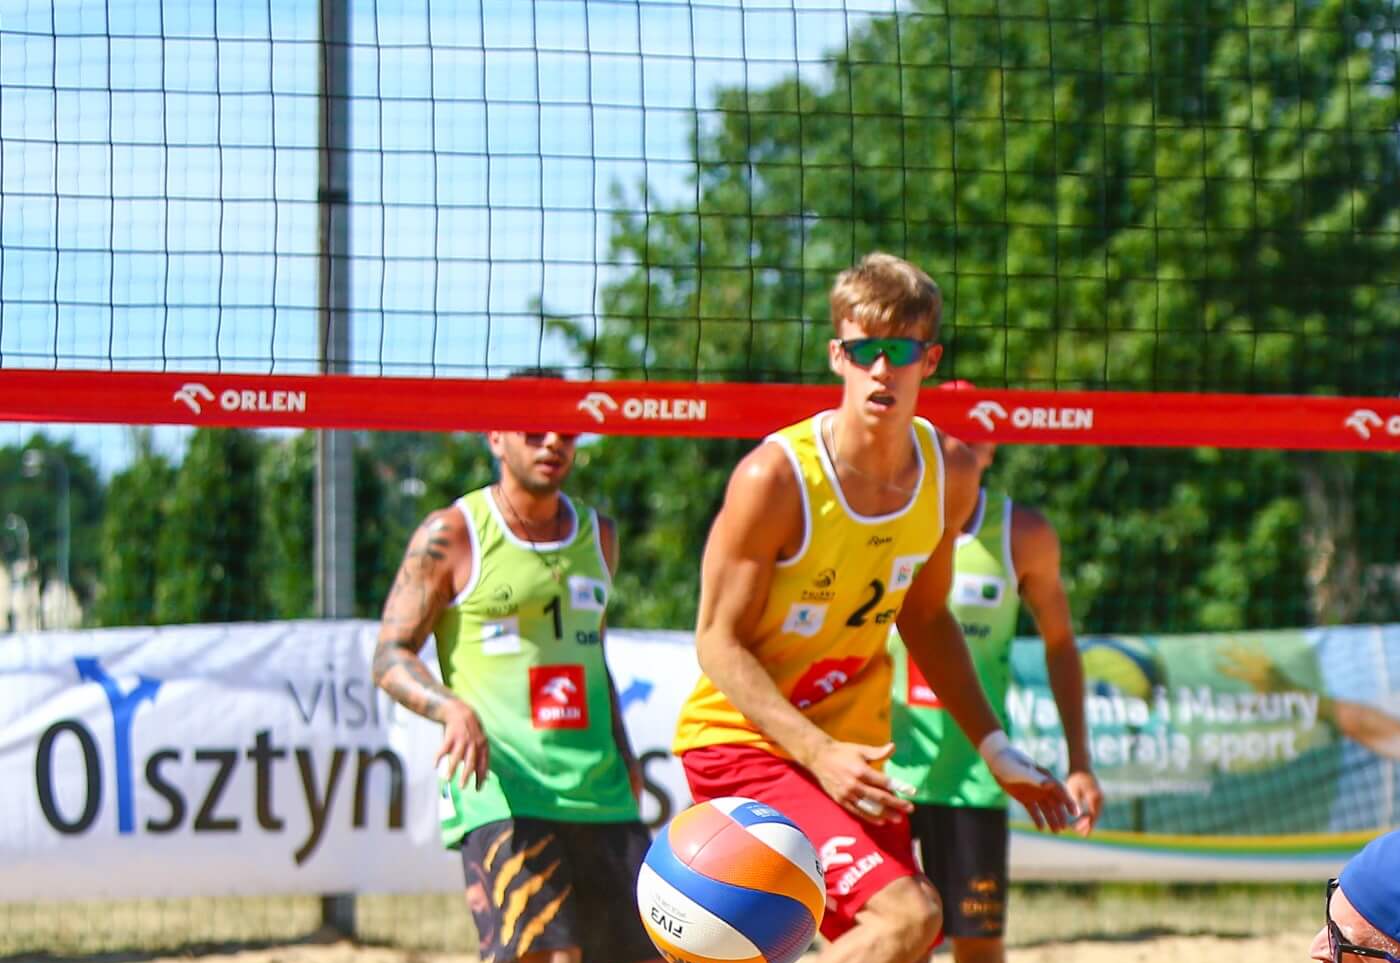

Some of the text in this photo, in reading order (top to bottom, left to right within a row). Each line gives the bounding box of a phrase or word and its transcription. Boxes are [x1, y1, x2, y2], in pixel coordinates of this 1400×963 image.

[221, 390, 307, 413] ORLEN
[622, 398, 706, 422] ORLEN
[1012, 407, 1093, 430] ORLEN
[543, 595, 563, 641] 1
[846, 578, 886, 627] 2
[285, 662, 382, 730] visi
[1005, 685, 1150, 727] Wamia
[1176, 684, 1319, 731] Mazury
[36, 656, 406, 867] Olsztyn
[1200, 729, 1298, 774] sport
[838, 850, 885, 896] ORLEN
[650, 905, 683, 940] FIVB
